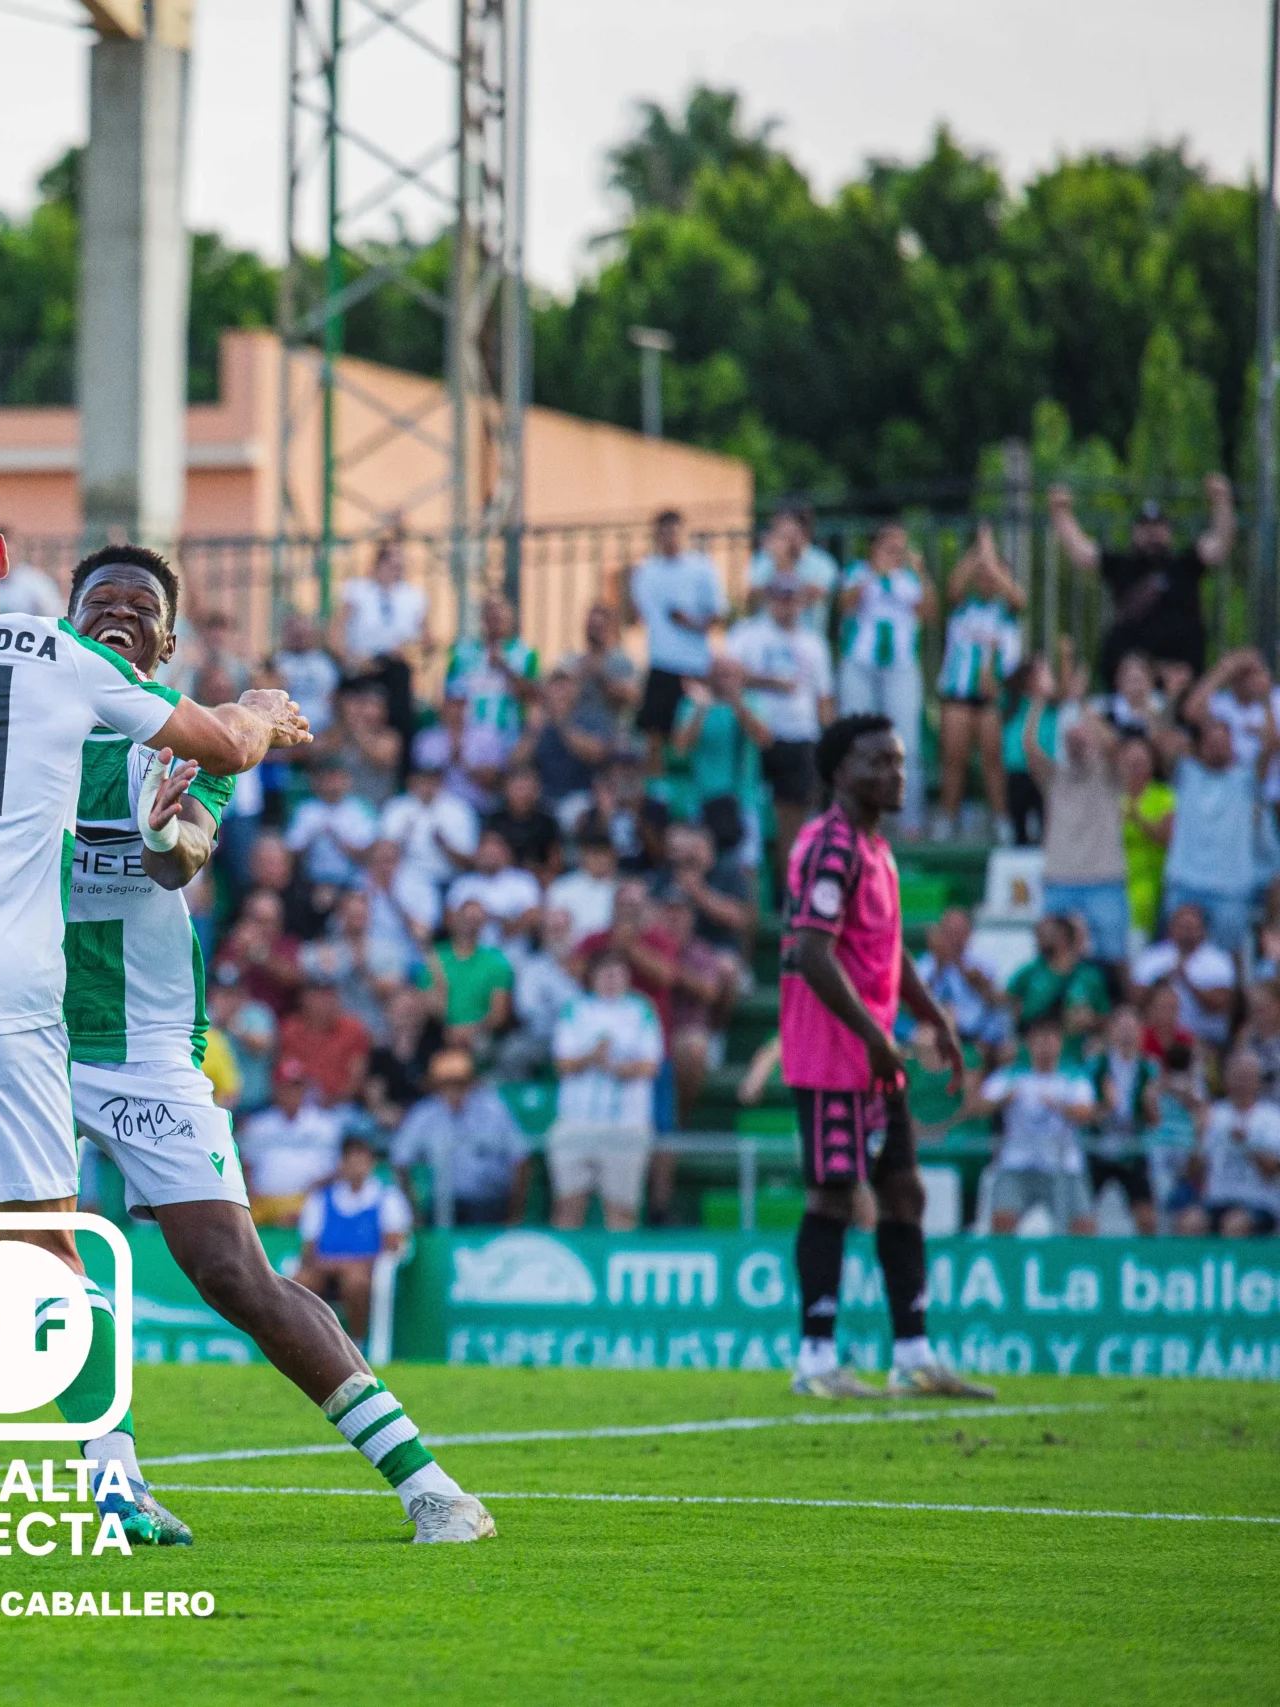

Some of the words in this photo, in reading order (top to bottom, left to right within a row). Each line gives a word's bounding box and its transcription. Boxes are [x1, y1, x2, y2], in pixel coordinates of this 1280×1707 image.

[87, 884, 103, 895] de
[106, 884, 153, 895] Seguros
[1023, 1254, 1100, 1312] La
[1121, 1256, 1280, 1314] balle
